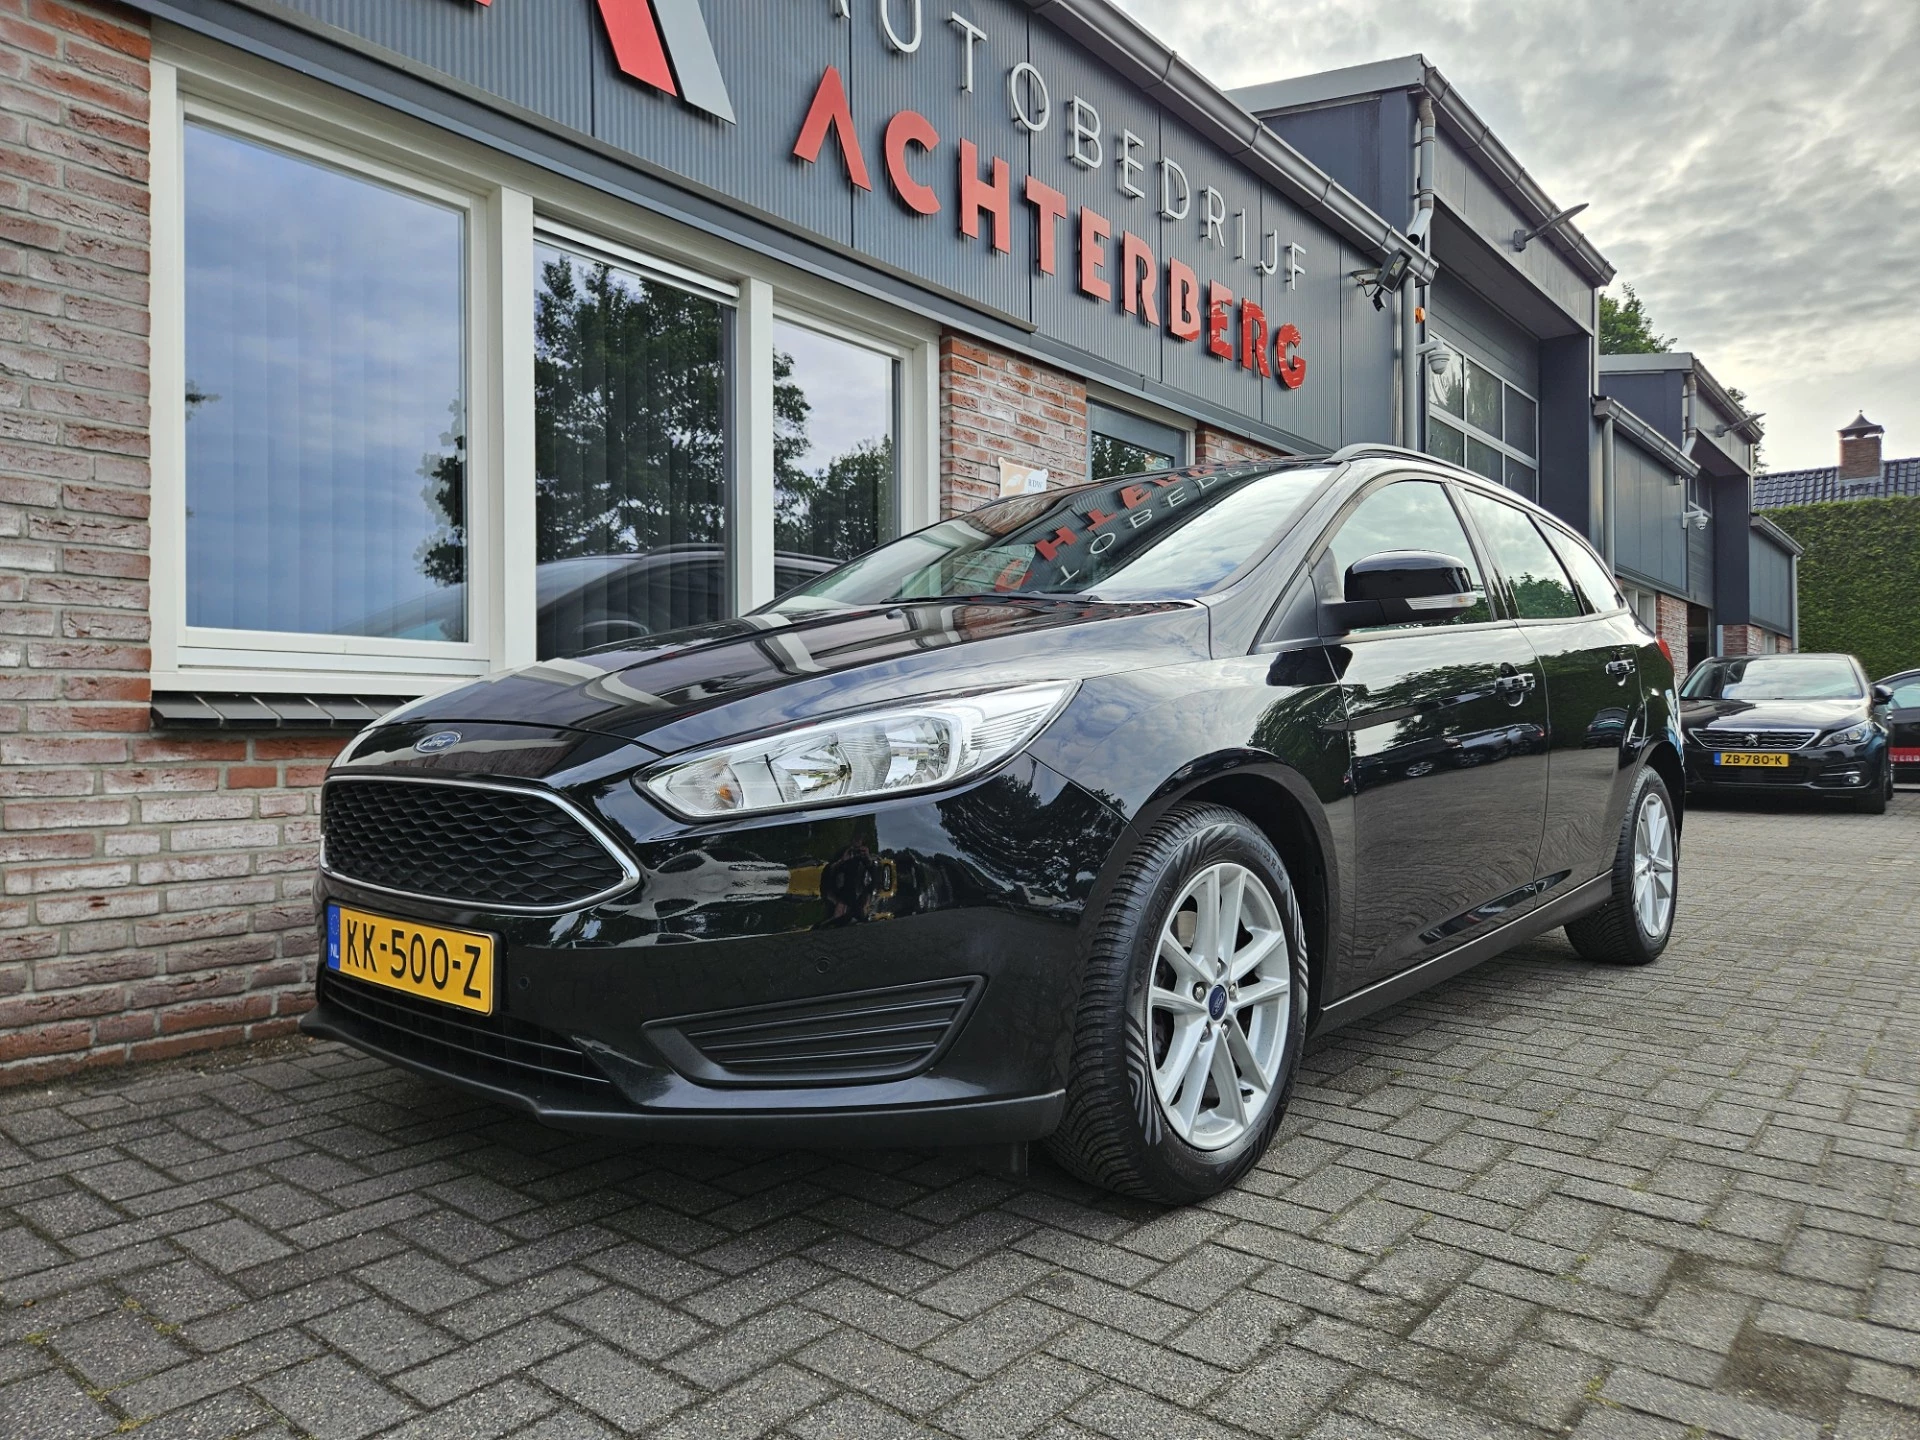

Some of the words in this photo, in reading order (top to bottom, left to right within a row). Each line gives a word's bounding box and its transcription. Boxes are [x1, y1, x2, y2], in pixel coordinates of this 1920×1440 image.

[838, 0, 1307, 290] UTOBEDRIJF
[793, 64, 1307, 390] ACHTERBERG
[1724, 754, 1782, 765] ZB-780-K
[329, 943, 340, 959] NL
[346, 918, 482, 999] KK-500-Z
